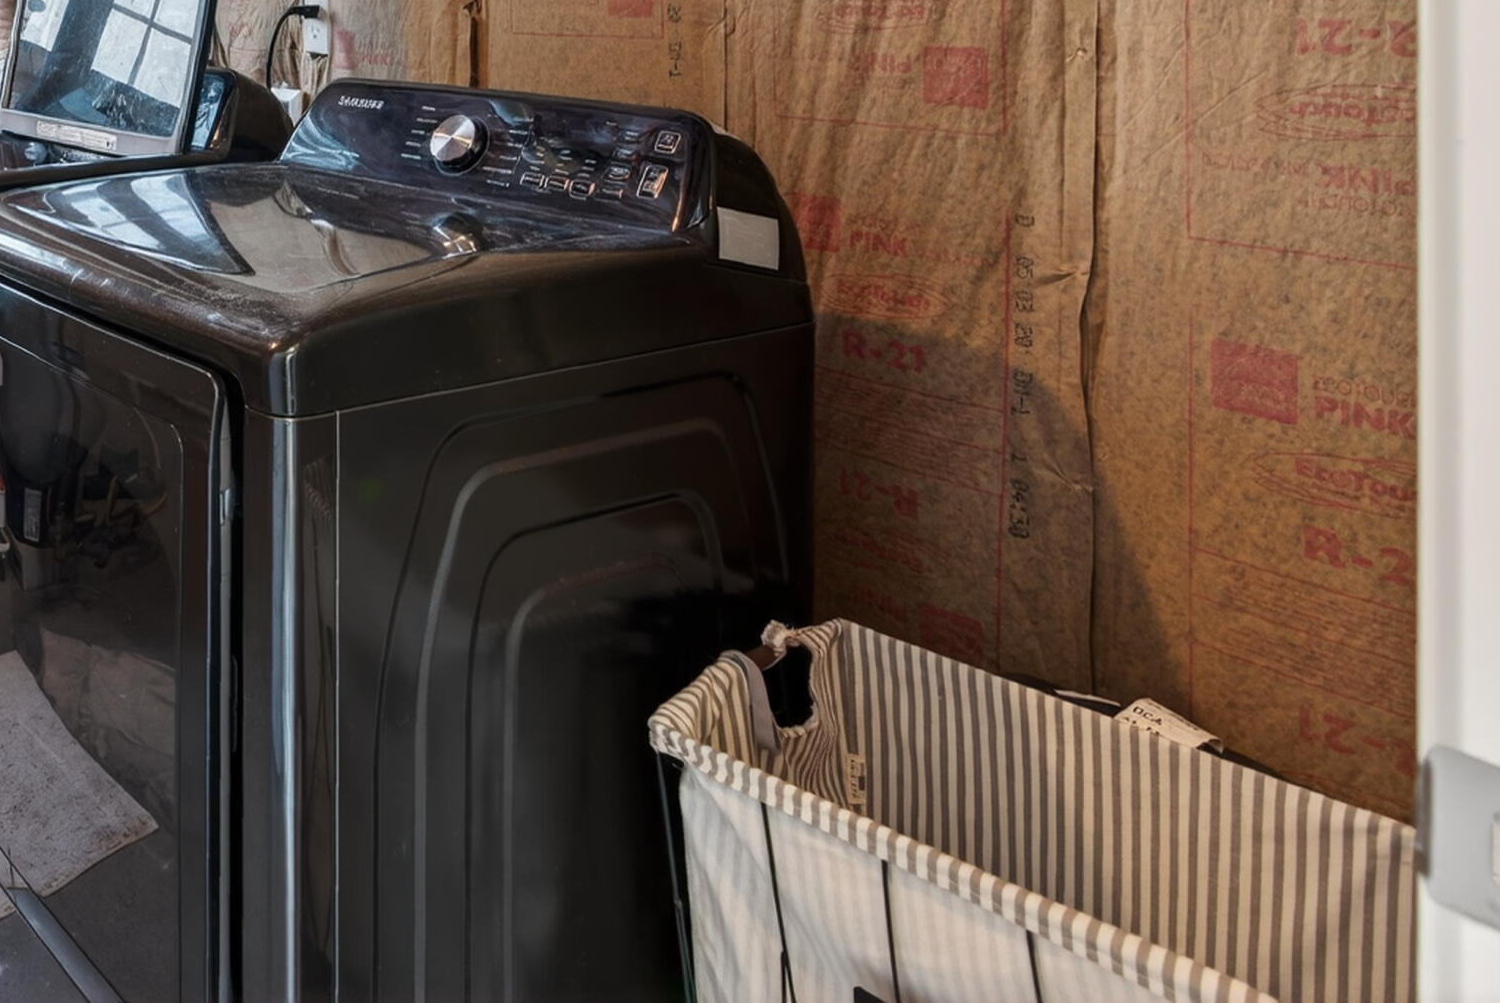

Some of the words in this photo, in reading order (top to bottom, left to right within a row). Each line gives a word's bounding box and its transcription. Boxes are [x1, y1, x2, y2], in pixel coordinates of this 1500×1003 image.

[1296, 16, 1416, 58] R-21
[851, 231, 908, 259] PINK
[841, 328, 924, 375] R-21
[1312, 374, 1415, 408] ECOTOUC
[1314, 394, 1415, 440] PINK
[838, 468, 921, 520] R-21
[1303, 522, 1414, 588] R-2
